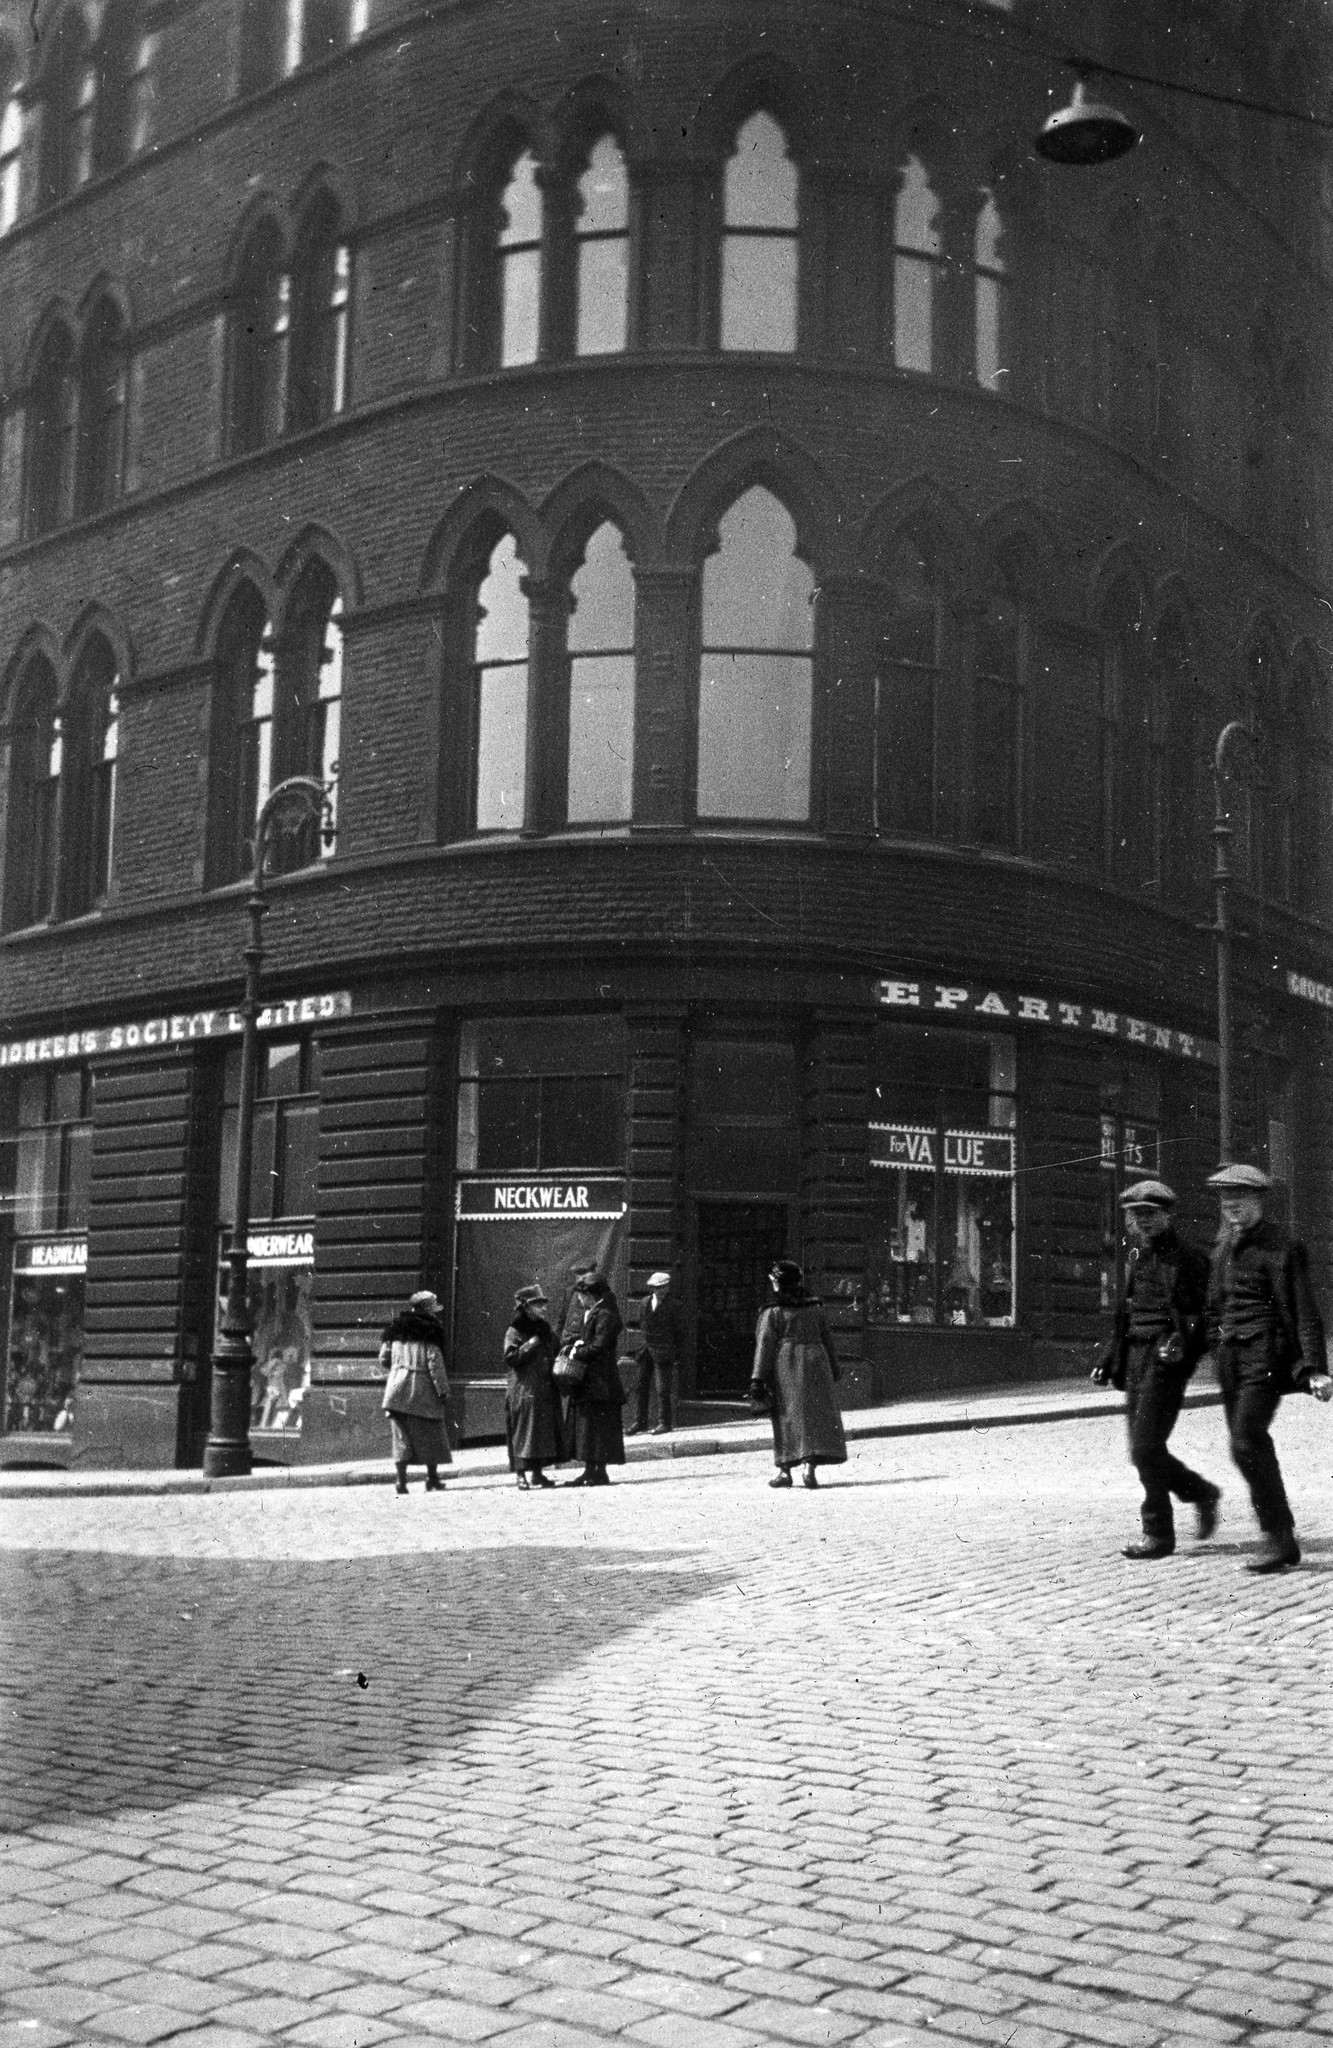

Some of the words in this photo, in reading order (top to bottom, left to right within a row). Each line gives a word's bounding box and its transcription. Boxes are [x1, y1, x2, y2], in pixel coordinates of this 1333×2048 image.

[109, 1009, 216, 1048] SOCIETY
[229, 995, 335, 1030] LMITED
[494, 1186, 589, 1208] NECKWEAR
